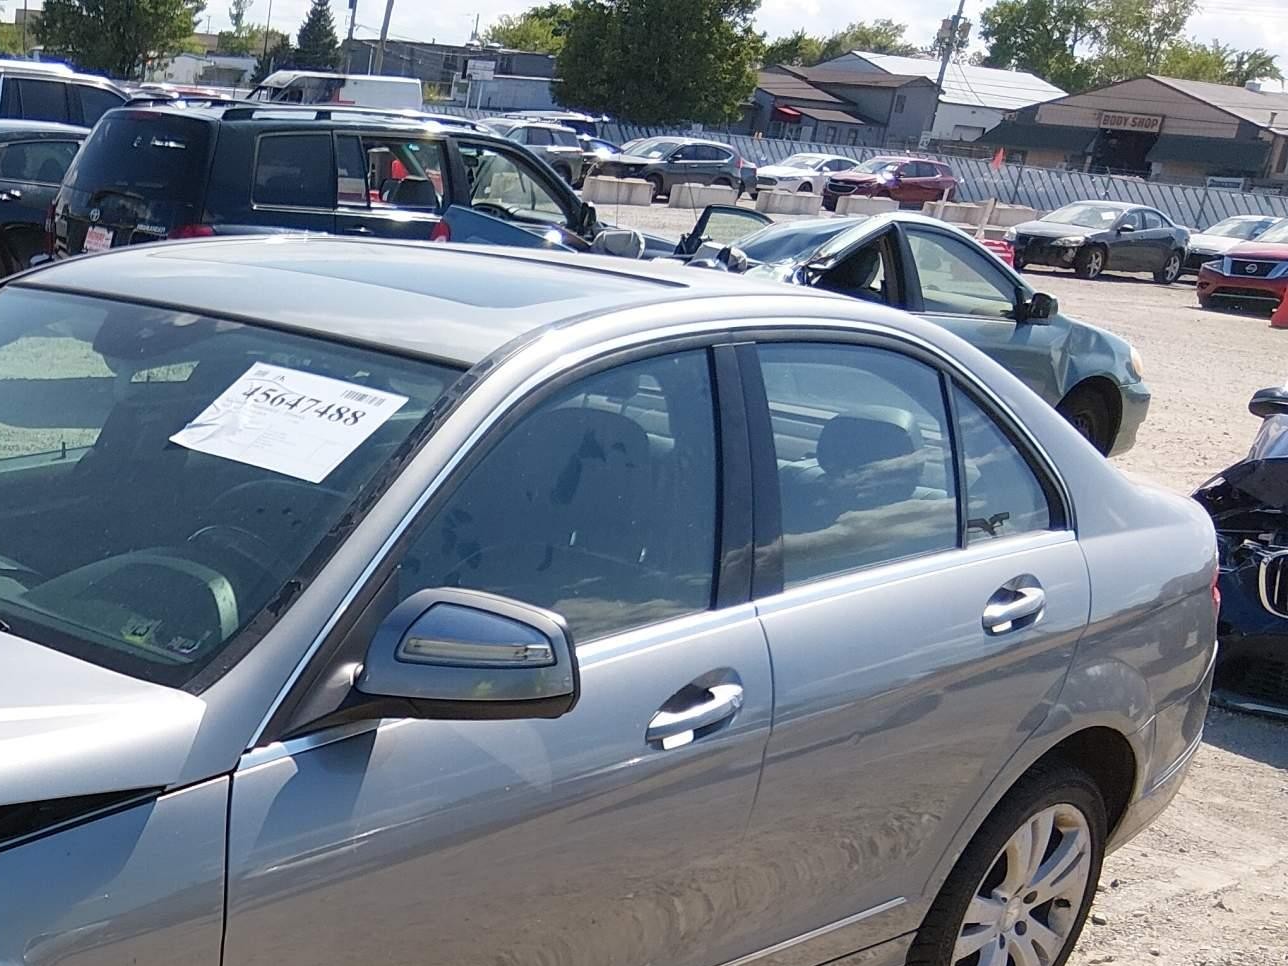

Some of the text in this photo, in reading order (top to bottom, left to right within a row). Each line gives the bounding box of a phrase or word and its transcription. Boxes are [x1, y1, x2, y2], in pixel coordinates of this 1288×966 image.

[1103, 115, 1158, 129] BODY SHOP
[242, 384, 367, 426] 45647488
